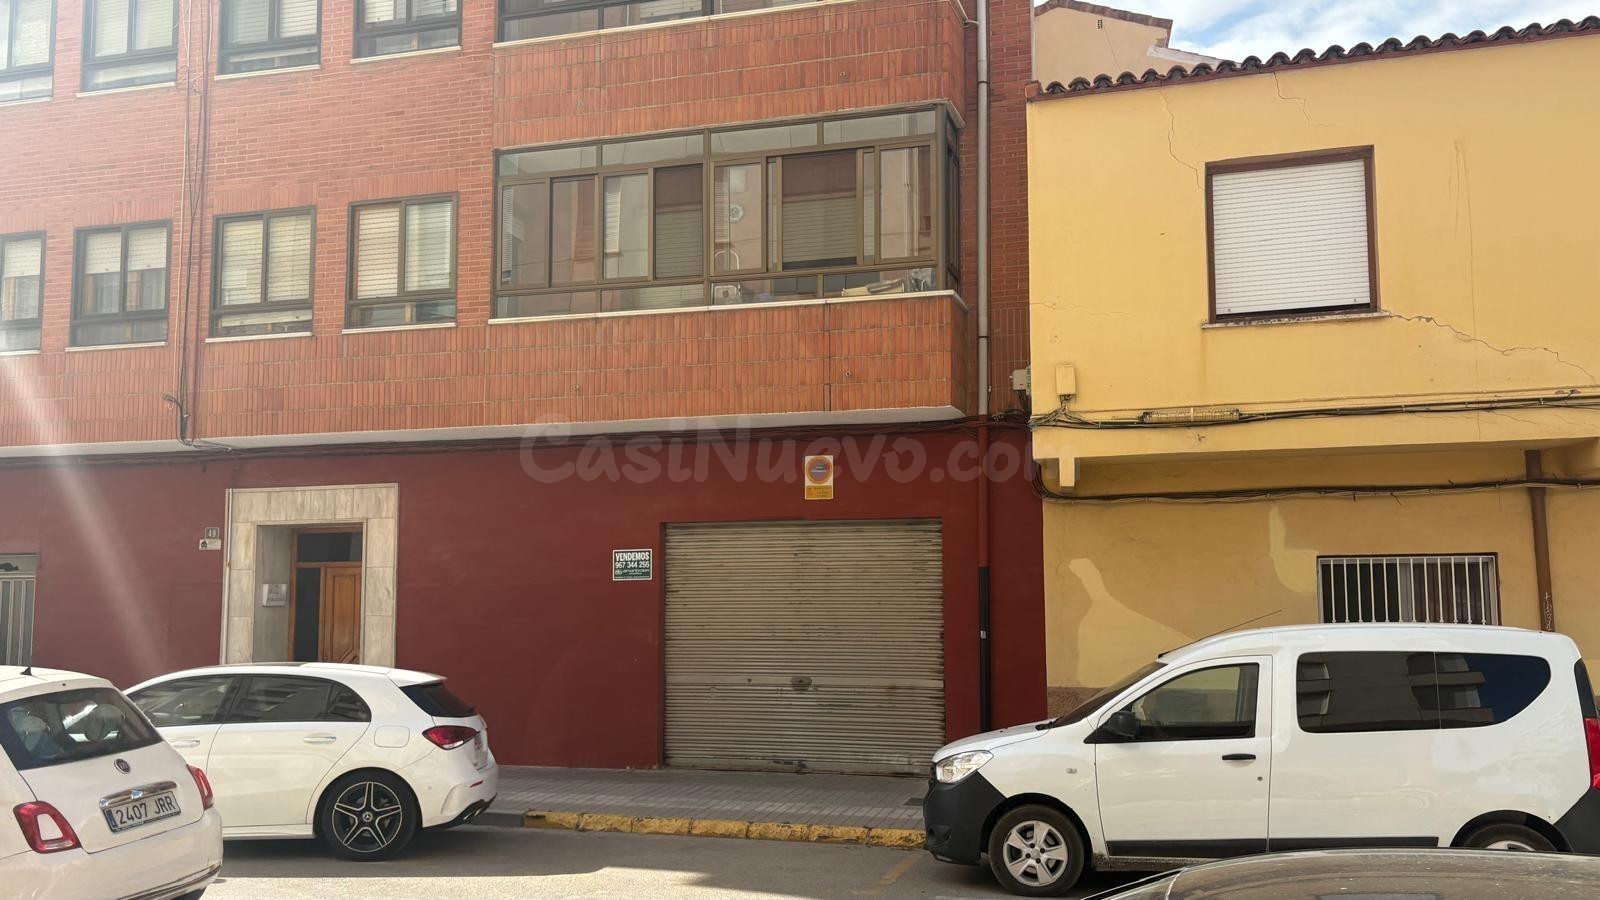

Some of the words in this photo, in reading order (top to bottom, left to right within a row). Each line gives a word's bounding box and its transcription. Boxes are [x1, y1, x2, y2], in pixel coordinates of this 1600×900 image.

[615, 551, 650, 562] VENDEMOS
[614, 561, 626, 569] 967
[626, 561, 638, 569] 344
[115, 802, 148, 825] 2407
[154, 795, 176, 815] JRR
